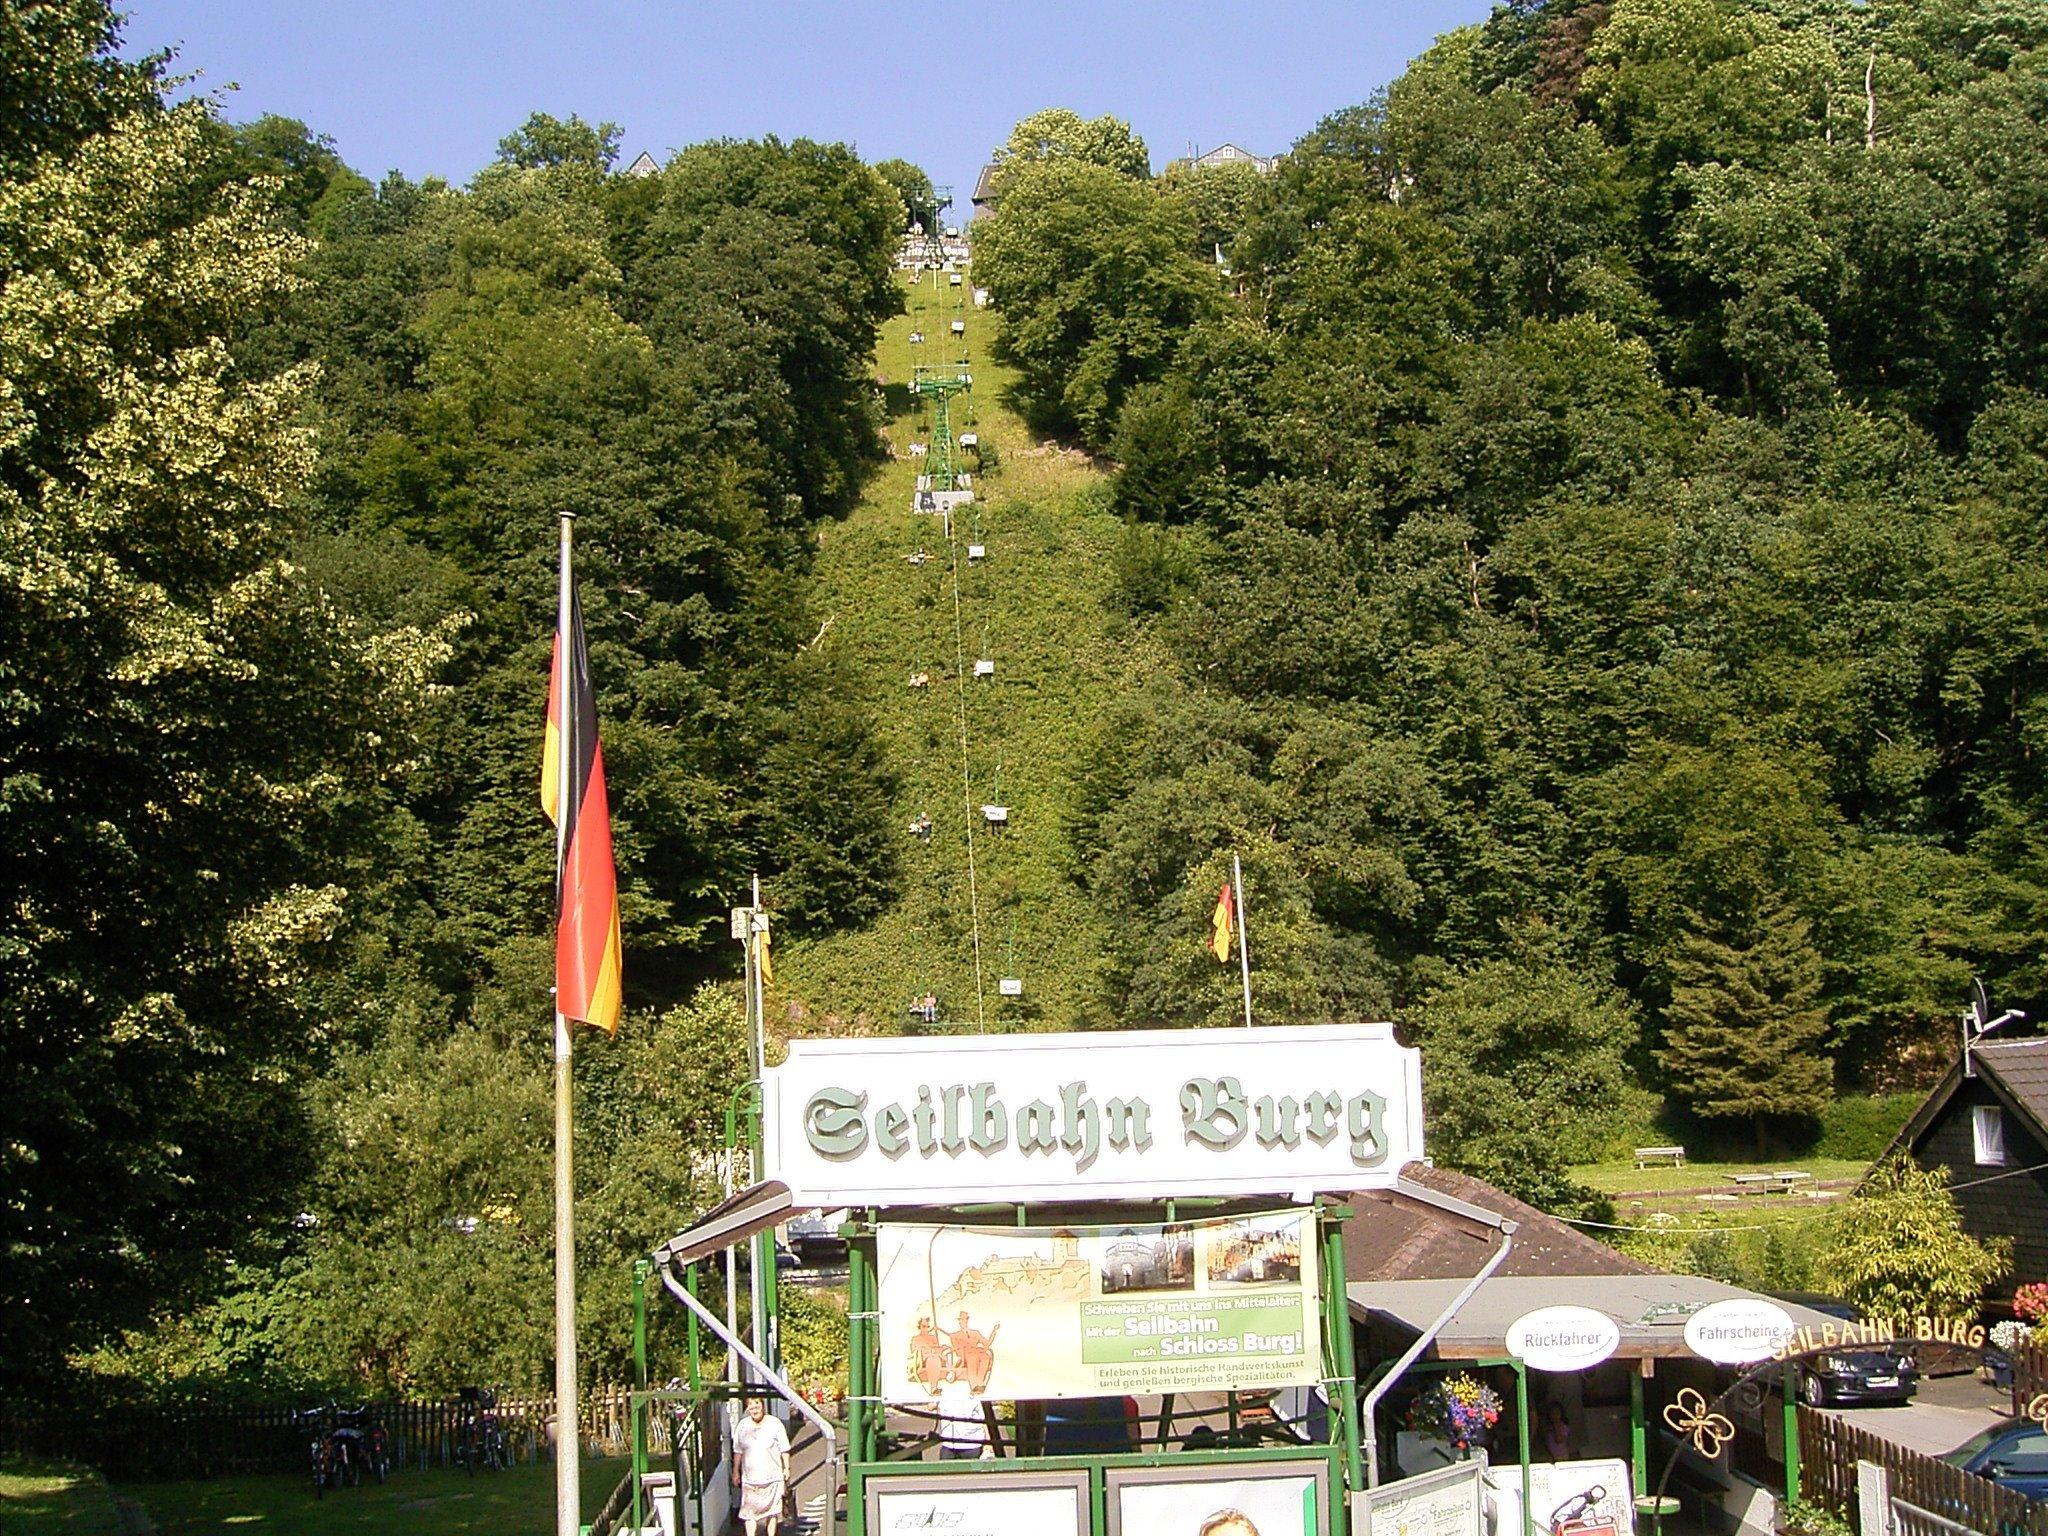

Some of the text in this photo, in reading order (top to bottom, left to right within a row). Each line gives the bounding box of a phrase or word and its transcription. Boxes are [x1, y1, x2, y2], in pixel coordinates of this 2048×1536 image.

[803, 1077, 1388, 1174] Seilbahn Burg
[1085, 1303, 1145, 1316] Schweben
[1146, 1301, 1165, 1313] Sie
[1167, 1300, 1190, 1312] mit
[1191, 1300, 1212, 1312] uns
[1215, 1298, 1232, 1310] ins
[1104, 1326, 1120, 1336] der
[1124, 1314, 1218, 1336] Seilbahn
[1699, 1325, 1780, 1340] Fahrscheine
[1133, 1330, 1302, 1357] nach Schloss Burg!
[1525, 1332, 1601, 1347] Rückfahrer
[1771, 1316, 1985, 1361] SEILBAHN BURG
[1100, 1360, 1304, 1378] Erleben Sie historische Handwerkskunst
[1100, 1371, 1295, 1389] und genießen bergische Spezialitäten.
